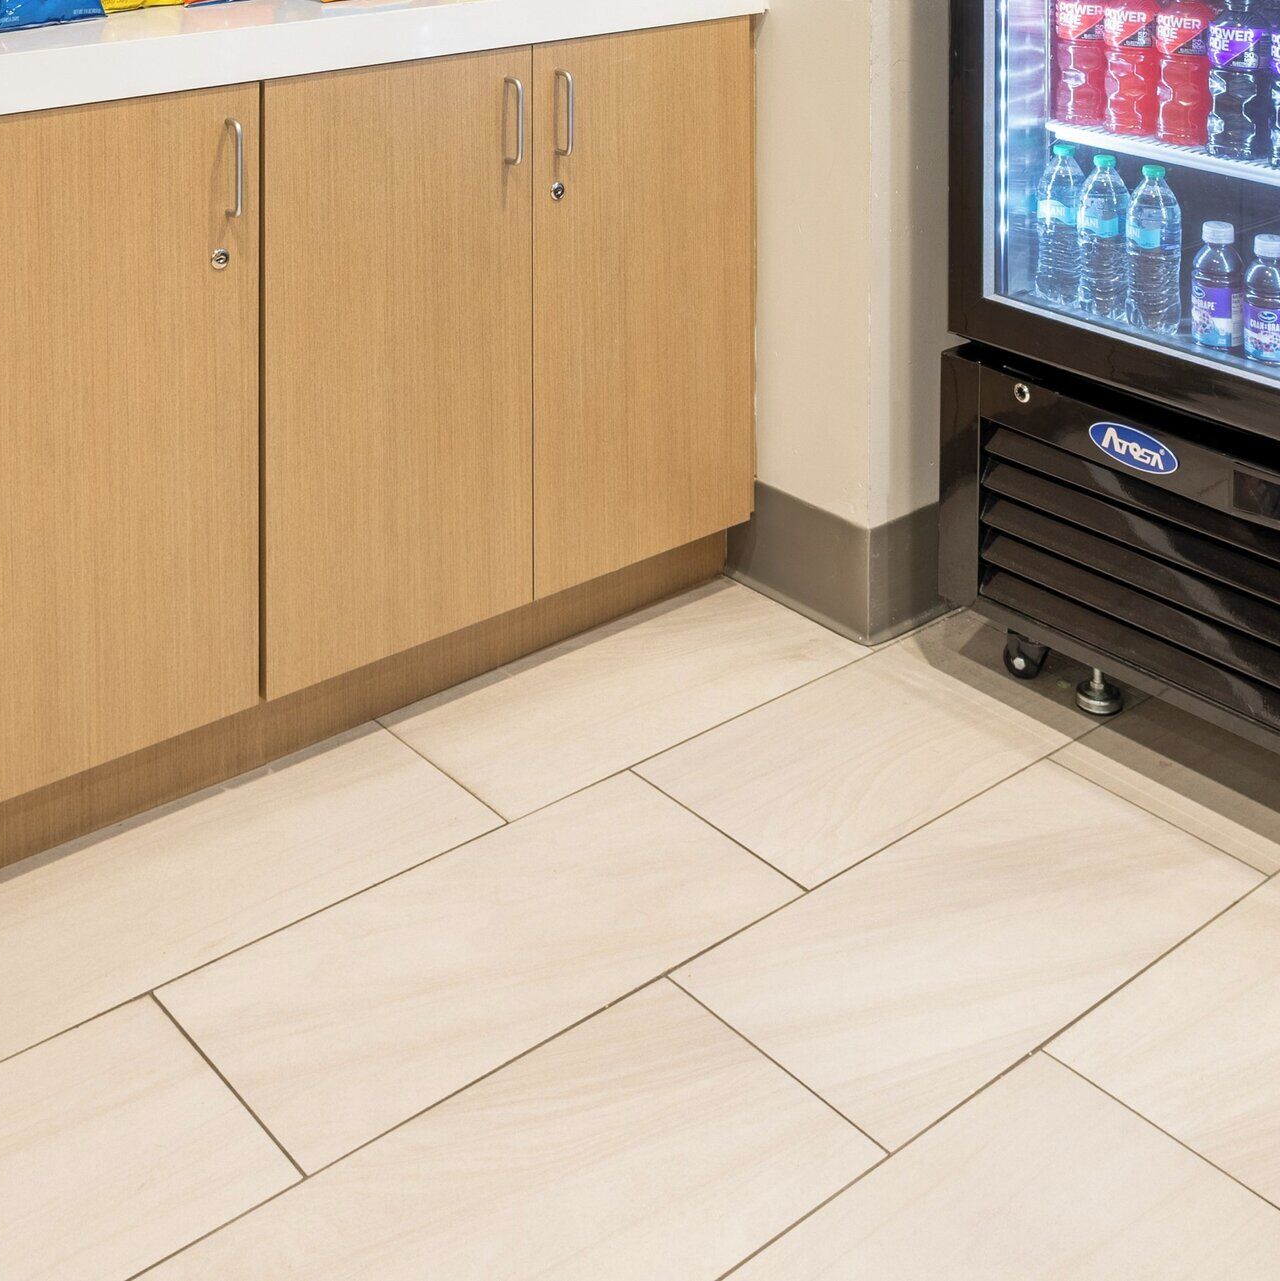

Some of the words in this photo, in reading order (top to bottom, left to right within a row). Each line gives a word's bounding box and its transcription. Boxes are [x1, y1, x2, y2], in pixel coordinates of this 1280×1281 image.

[1058, 2, 1104, 18] POWER
[1157, 14, 1202, 31] POWER
[1210, 26, 1254, 43] POWER
